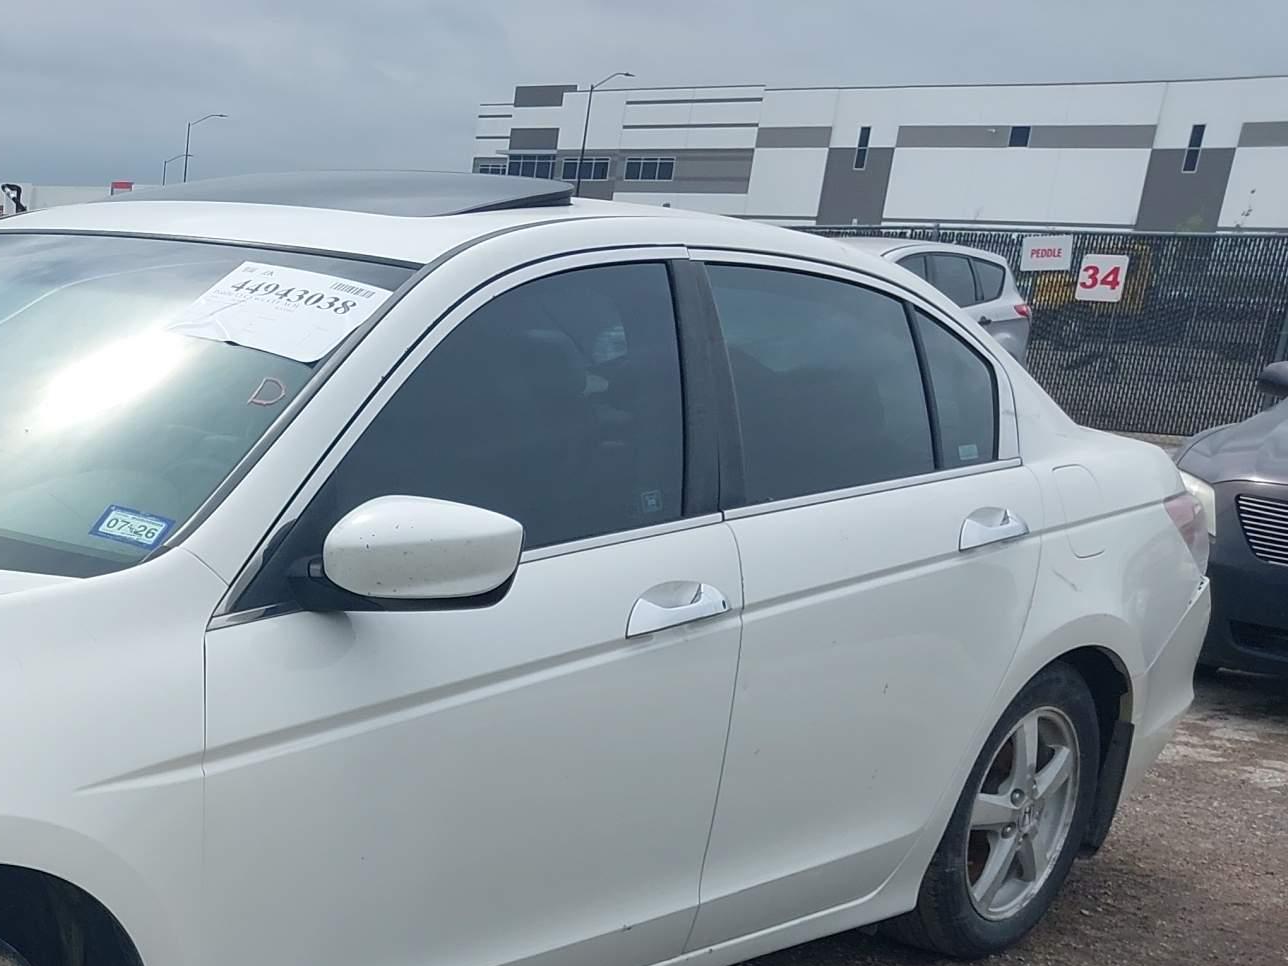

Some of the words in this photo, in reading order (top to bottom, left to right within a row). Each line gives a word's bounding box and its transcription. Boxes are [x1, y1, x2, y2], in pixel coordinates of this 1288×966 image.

[1030, 248, 1062, 258] PEDDLE
[1079, 265, 1120, 290] 34
[231, 279, 357, 315] 44943038
[247, 376, 286, 407] D
